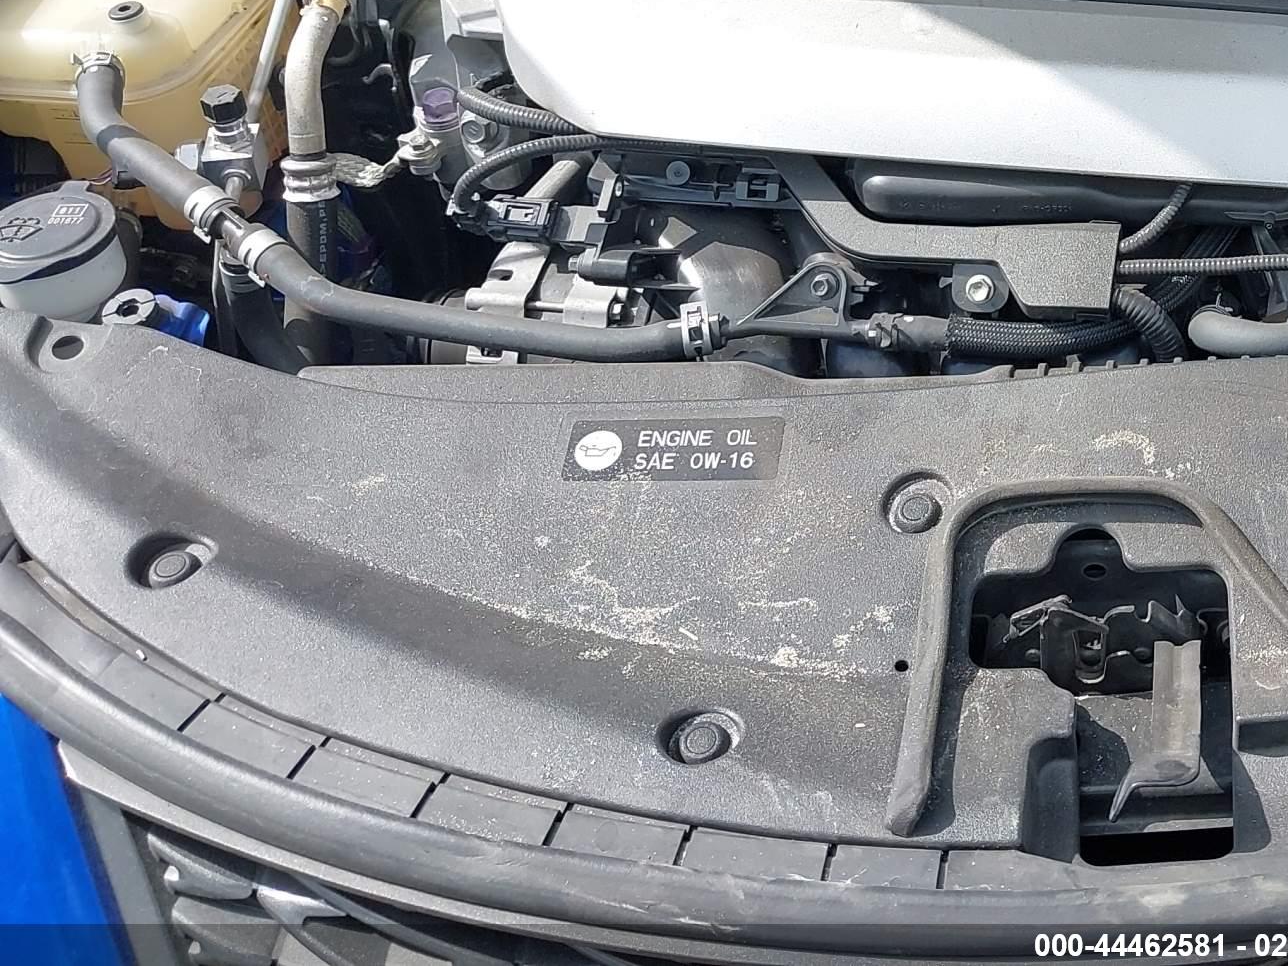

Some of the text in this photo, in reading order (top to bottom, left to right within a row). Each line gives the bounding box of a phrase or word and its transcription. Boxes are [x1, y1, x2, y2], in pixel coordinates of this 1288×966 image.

[637, 429, 757, 447] ENGINE OIL
[634, 452, 754, 470] SAE 0W-16
